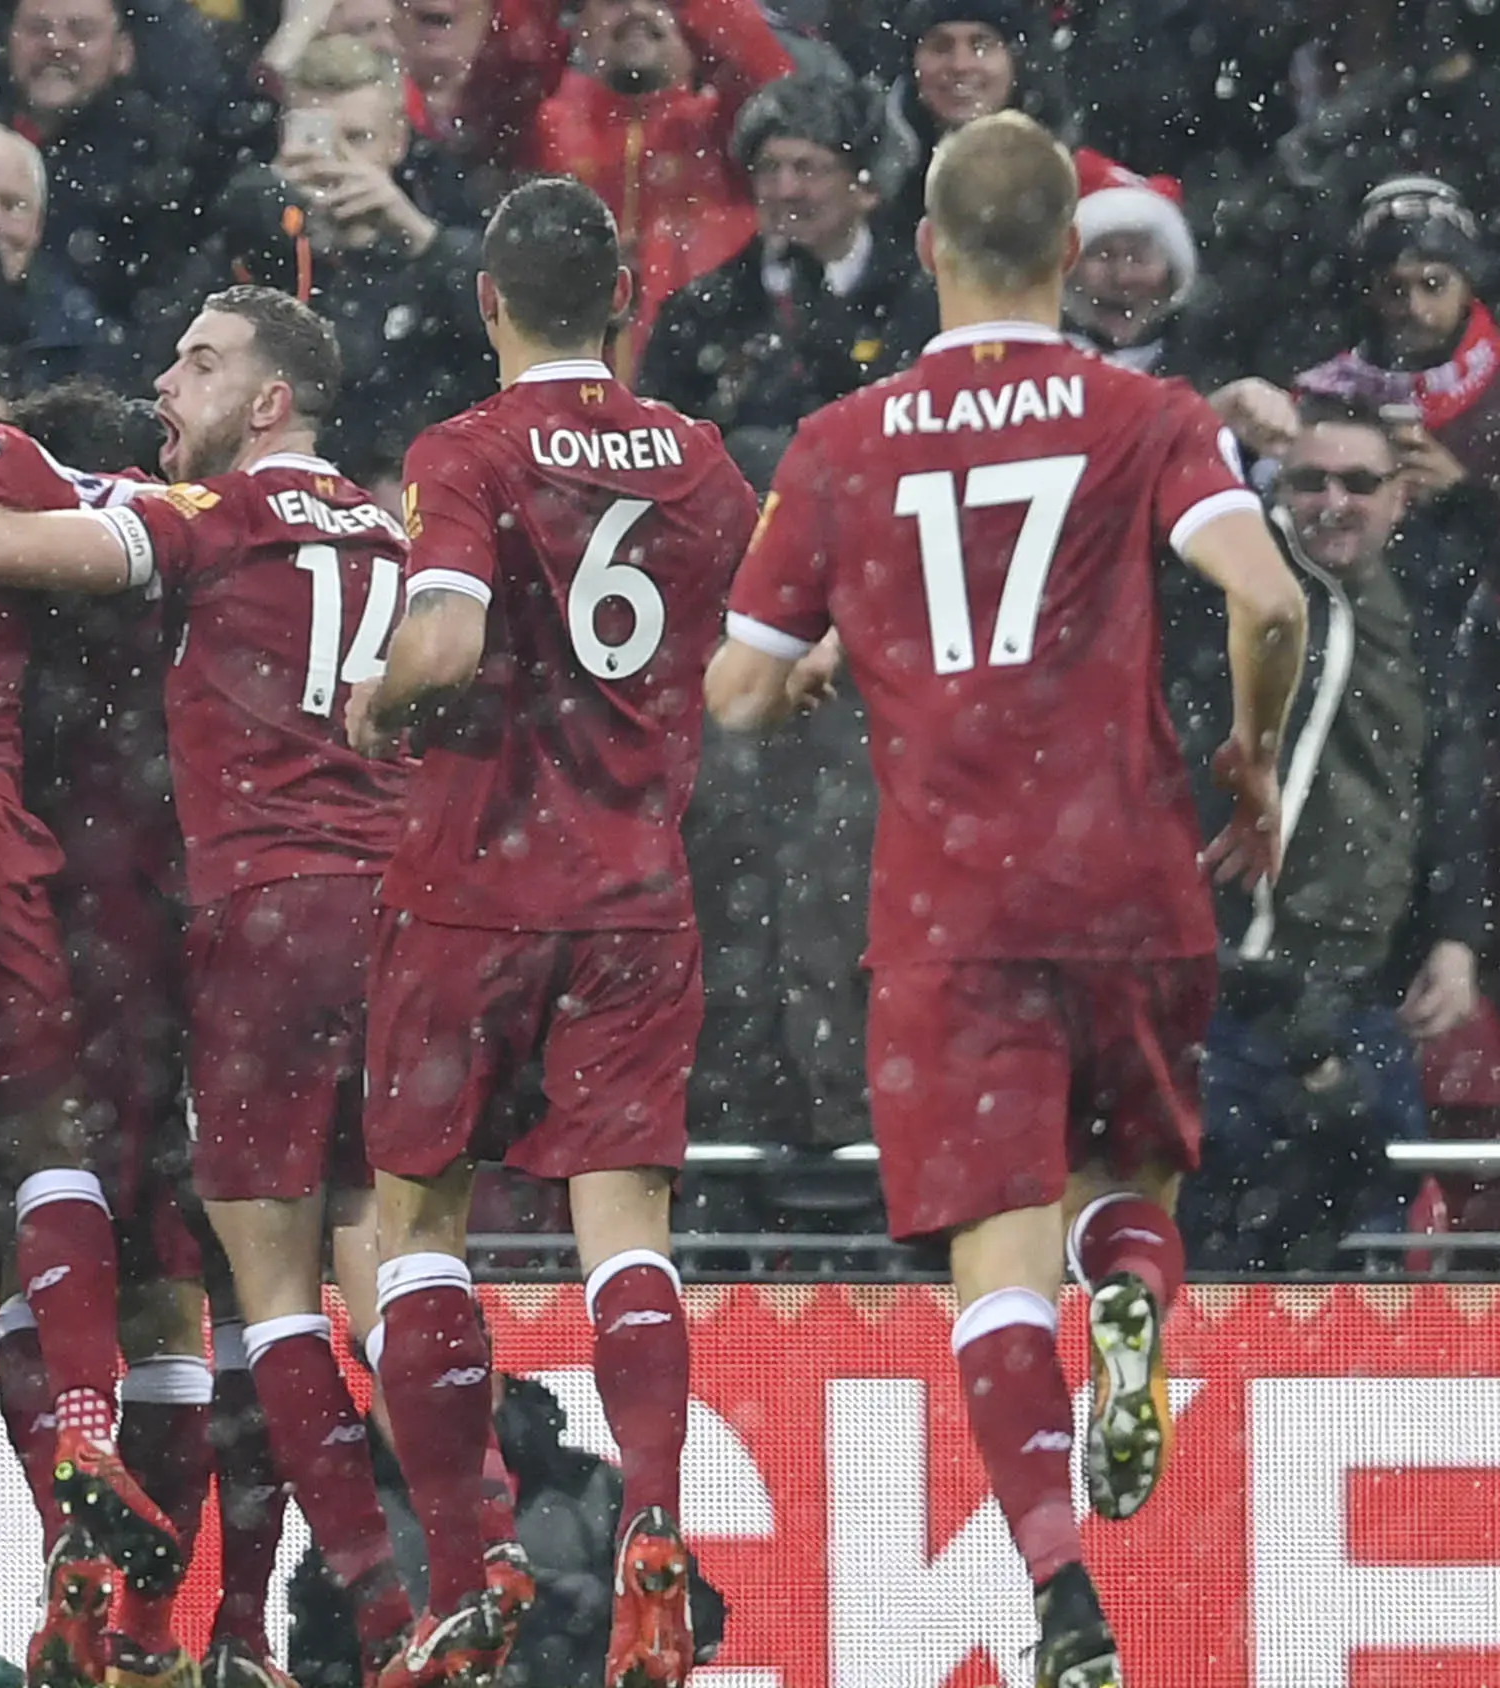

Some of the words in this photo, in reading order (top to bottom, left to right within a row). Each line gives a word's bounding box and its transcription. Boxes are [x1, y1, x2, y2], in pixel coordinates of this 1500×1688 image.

[529, 427, 684, 470] LOVREN
[883, 375, 1084, 436] KLAVAN
[568, 499, 665, 680] 6
[894, 454, 1088, 675] 17
